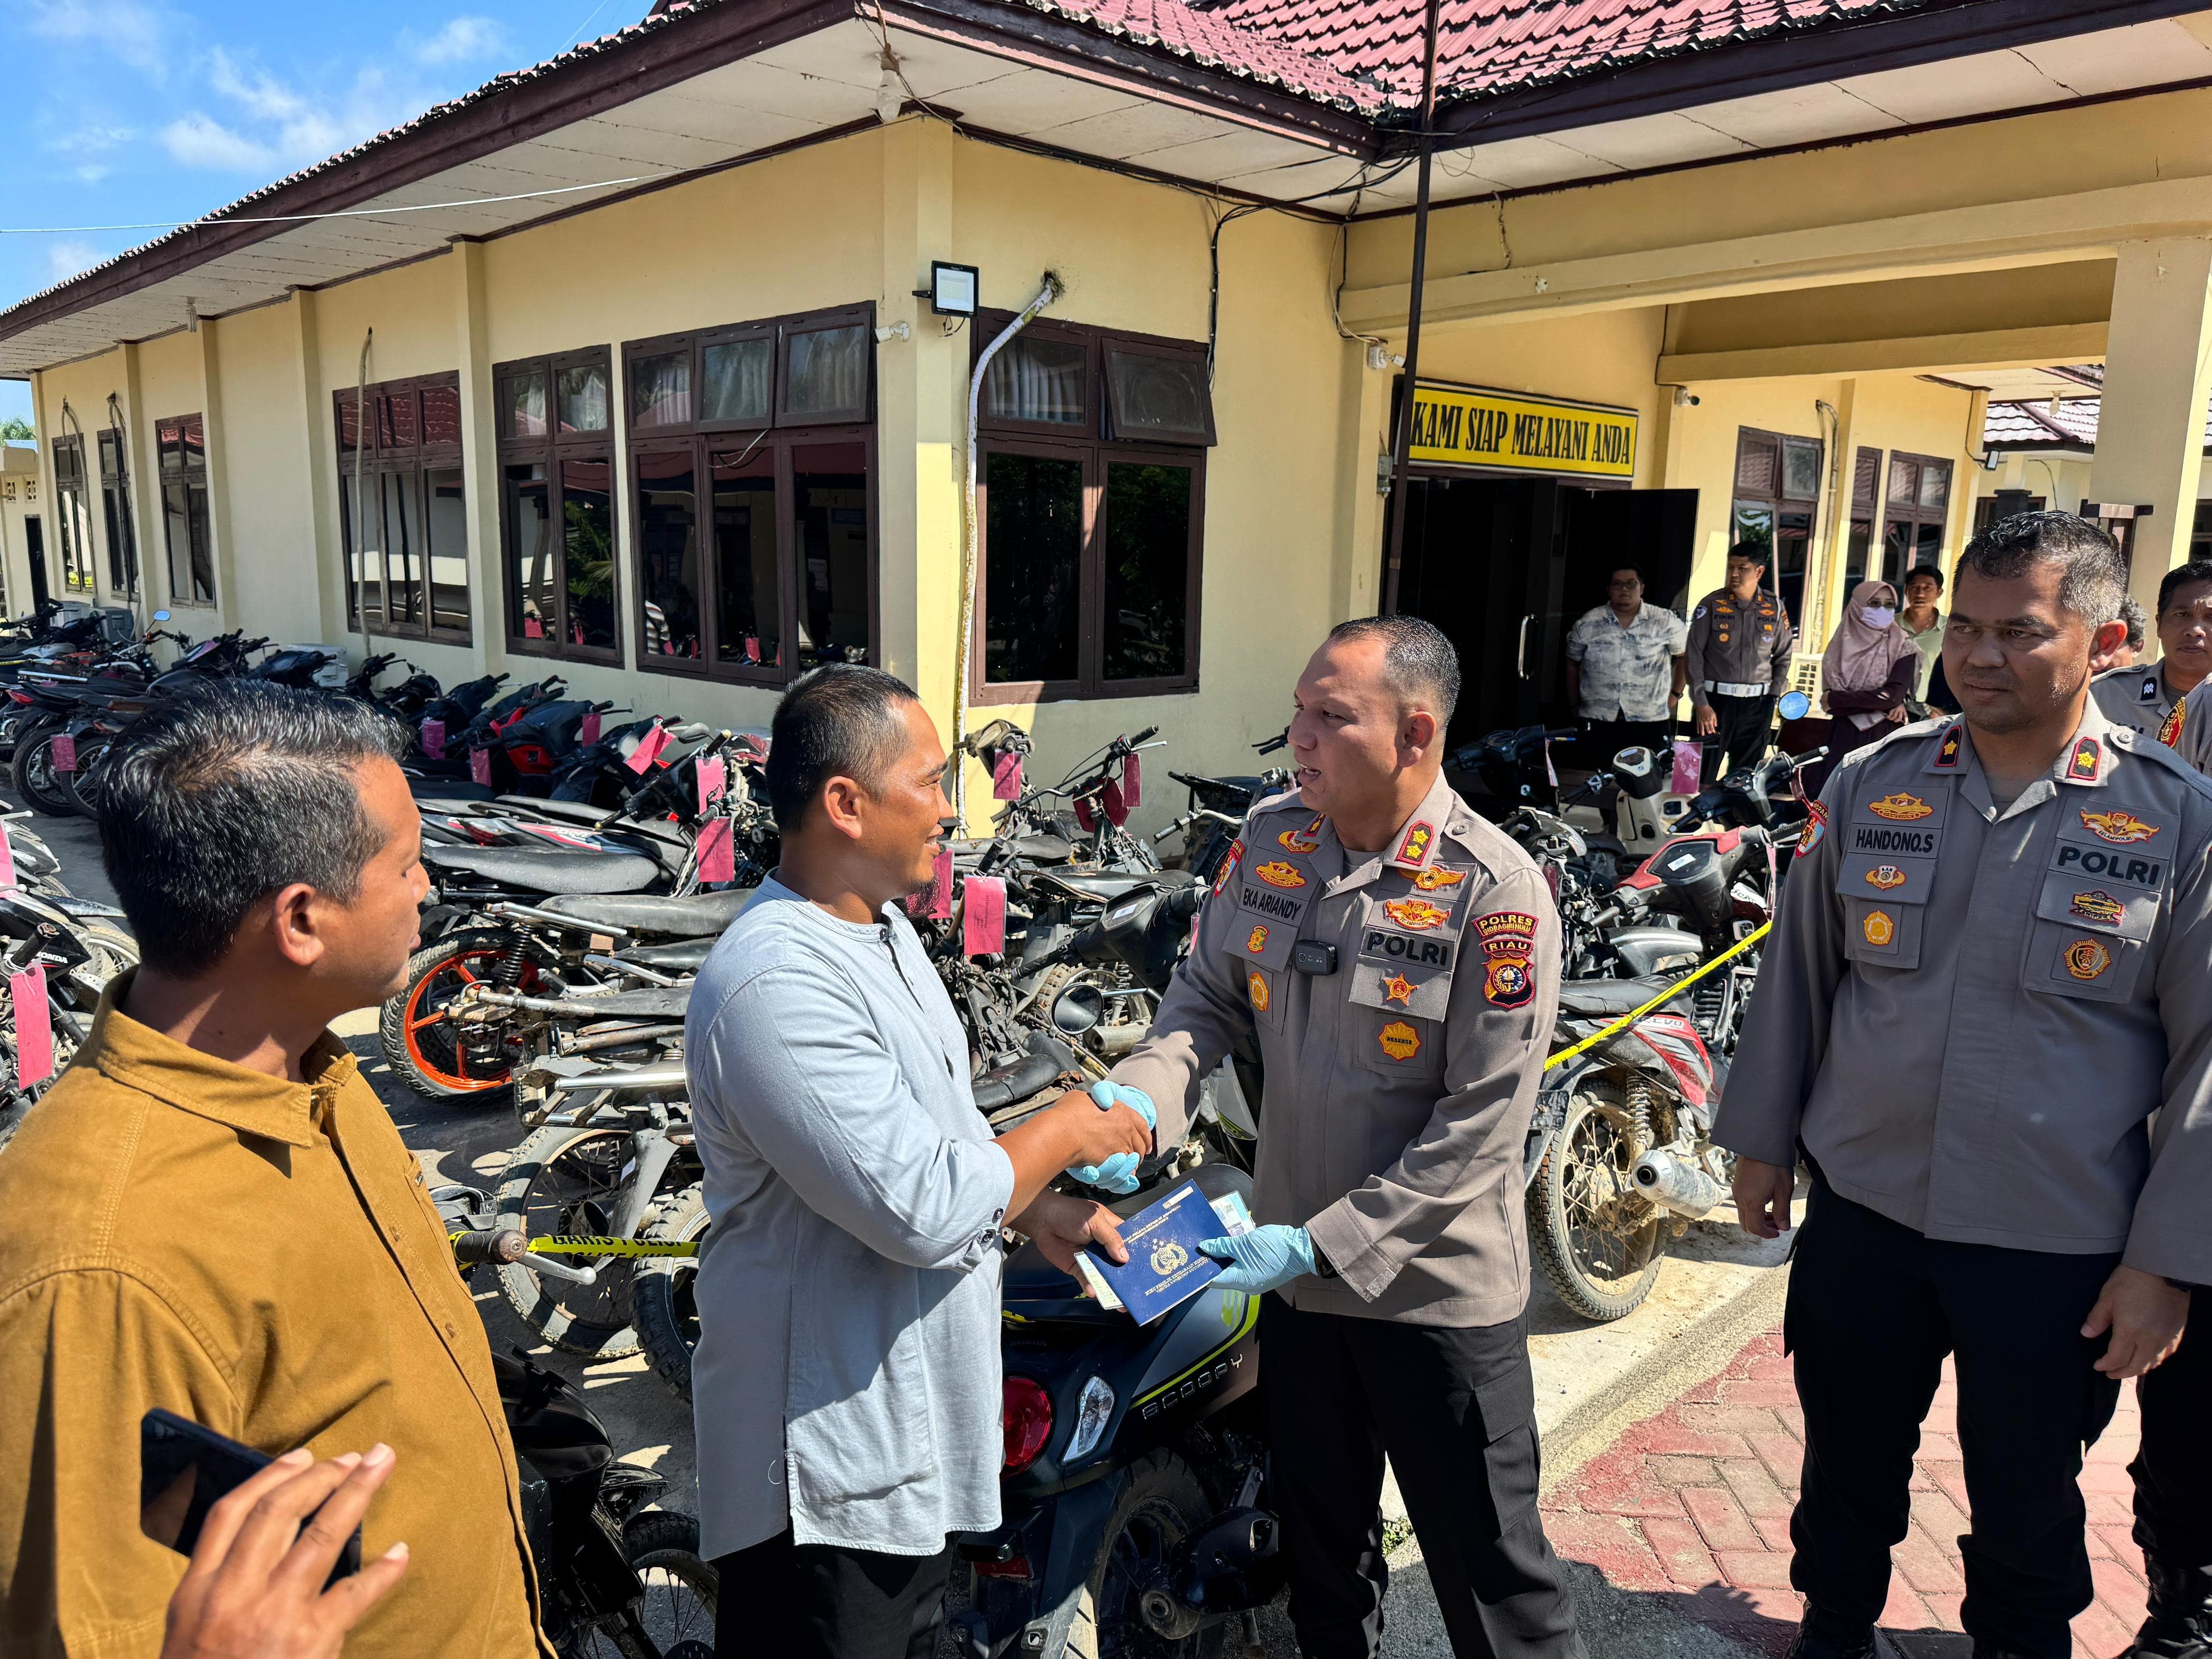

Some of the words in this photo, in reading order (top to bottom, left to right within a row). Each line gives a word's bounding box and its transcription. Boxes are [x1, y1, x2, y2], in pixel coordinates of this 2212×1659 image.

[1411, 402, 1463, 449] KAMI
[1466, 407, 1508, 453] SIAP
[1511, 413, 1589, 460] MELAYANI
[1591, 423, 1630, 464] ANDA
[1856, 829, 1934, 853] HANDONO.S
[2057, 846, 2160, 885] POLRI
[1243, 888, 1259, 909] EKA
[1258, 893, 1301, 920] ARIANDY
[1479, 915, 1533, 929] POLRES
[1367, 932, 1448, 966] POLRI
[1489, 941, 1527, 951] RIAU
[1386, 1036, 1413, 1045] RESERSE
[1142, 1353, 1243, 1420] SCOOPY
